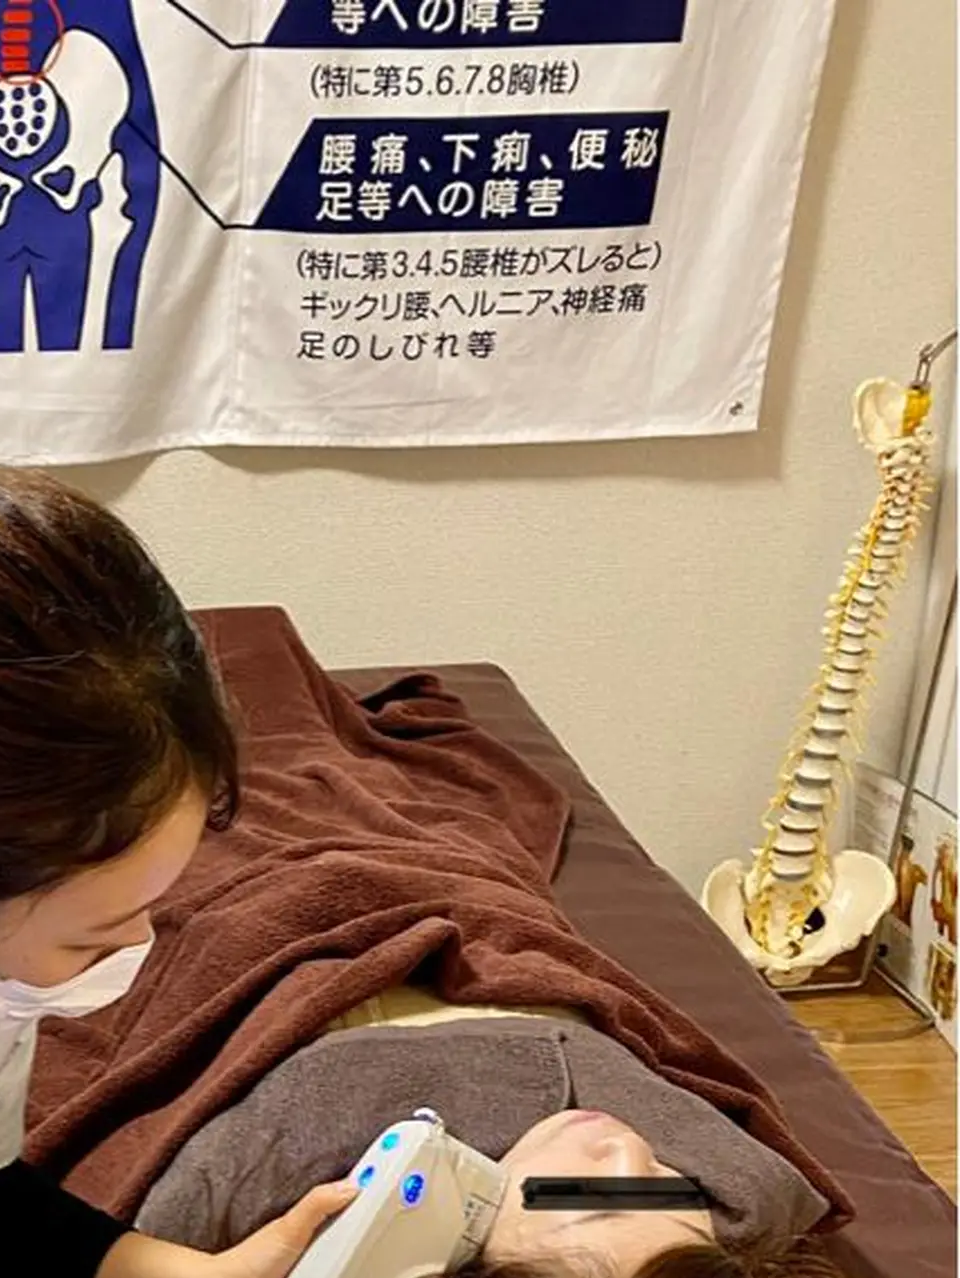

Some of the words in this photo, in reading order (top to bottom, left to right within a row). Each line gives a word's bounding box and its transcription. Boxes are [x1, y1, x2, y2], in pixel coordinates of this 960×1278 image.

[316, 178, 564, 222] 足等への障害
[297, 330, 497, 361] 足のしびれ等
